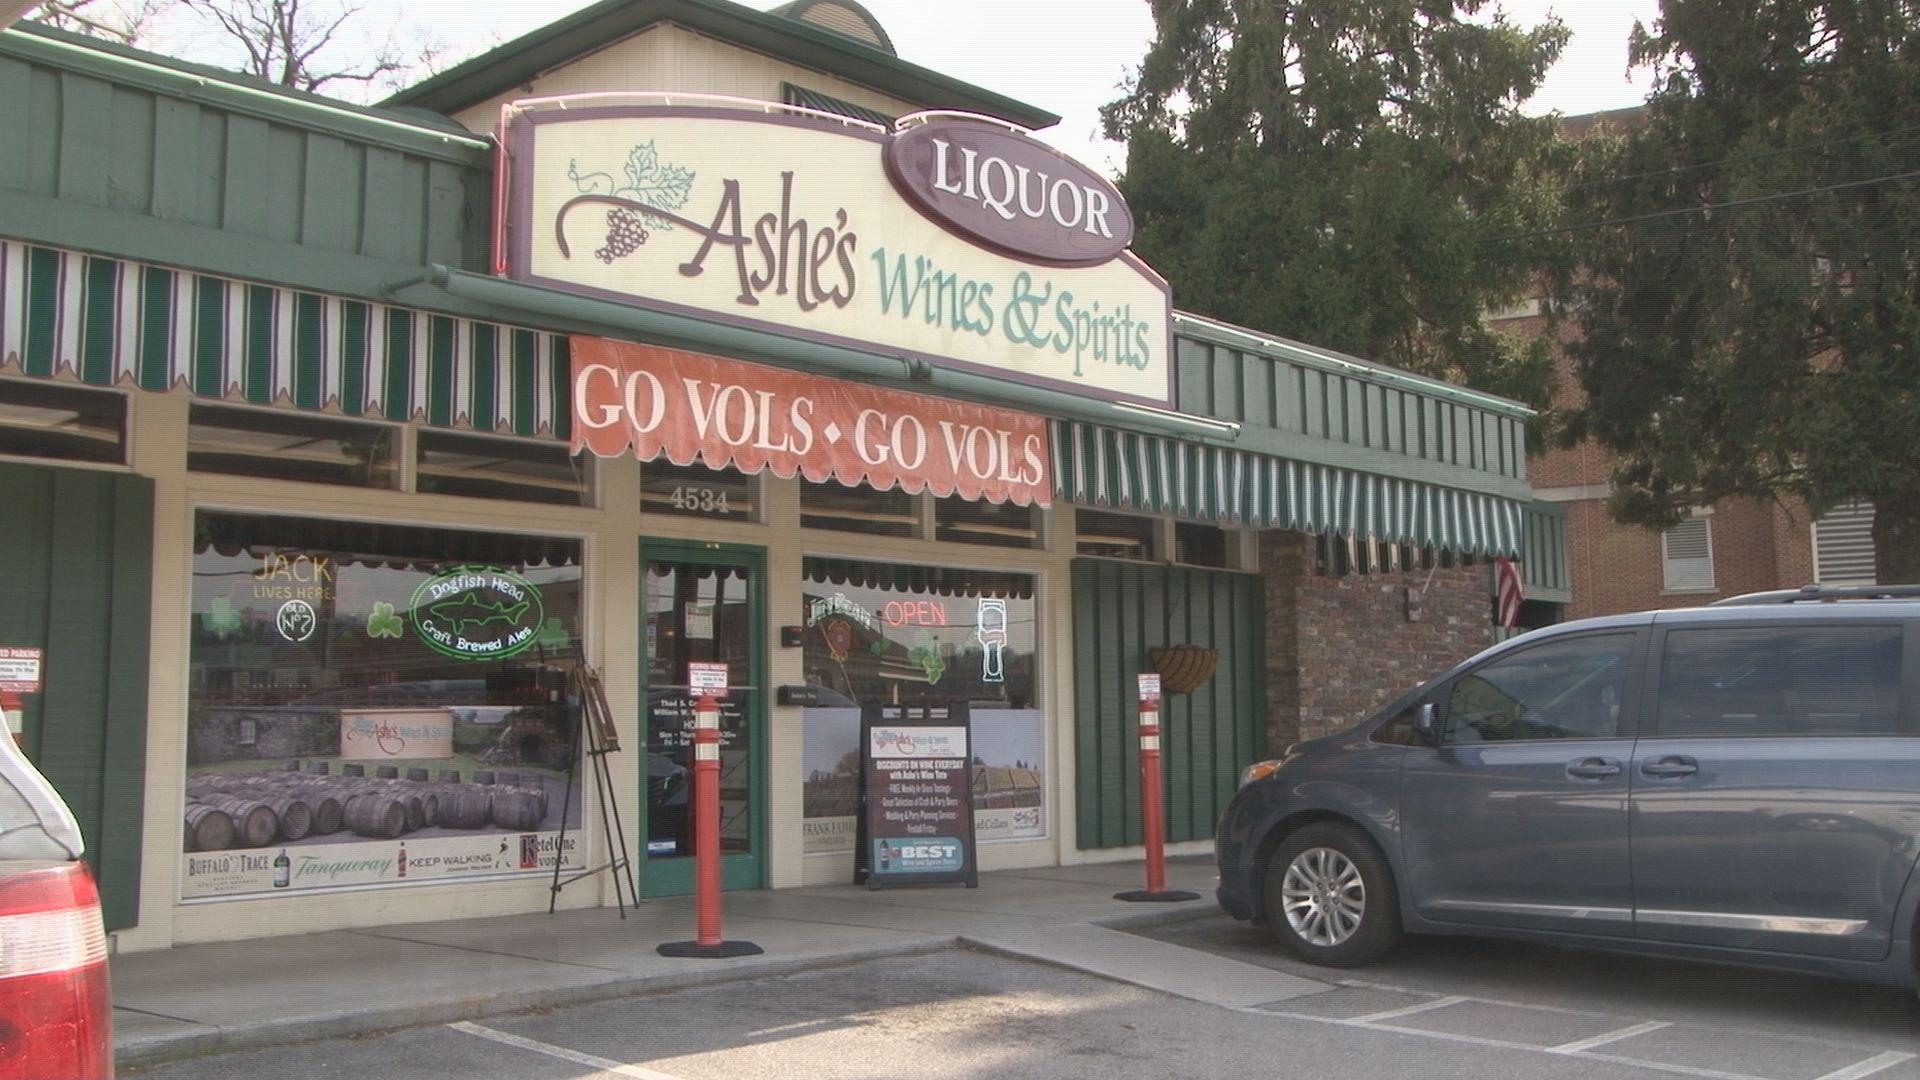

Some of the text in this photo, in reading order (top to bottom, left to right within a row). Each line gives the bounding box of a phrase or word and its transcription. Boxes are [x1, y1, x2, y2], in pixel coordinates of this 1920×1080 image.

[933, 138, 1113, 239] LIQUOR
[679, 170, 1150, 377] Ashe's Wines & Spirits
[575, 363, 814, 456] GO VOLS
[855, 408, 1044, 487] GO VOLS
[670, 485, 729, 513] 4534
[254, 554, 332, 582] JACK
[254, 586, 292, 599] LIVES
[430, 575, 525, 601] Dogfish Head
[286, 603, 306, 612] OLD
[884, 600, 946, 627] OPEN
[422, 619, 533, 652] Craft Brewed Ales
[10, 649, 40, 658] PARKING
[876, 760, 964, 770] DISCOUNTS ON WINE EVERYDAY
[803, 823, 831, 835] FRANK
[409, 853, 493, 868] KEEP WALKING
[902, 845, 956, 858] BEST
[189, 854, 269, 876] BUFFALO TRACE
[295, 855, 392, 879] Tanqueray
